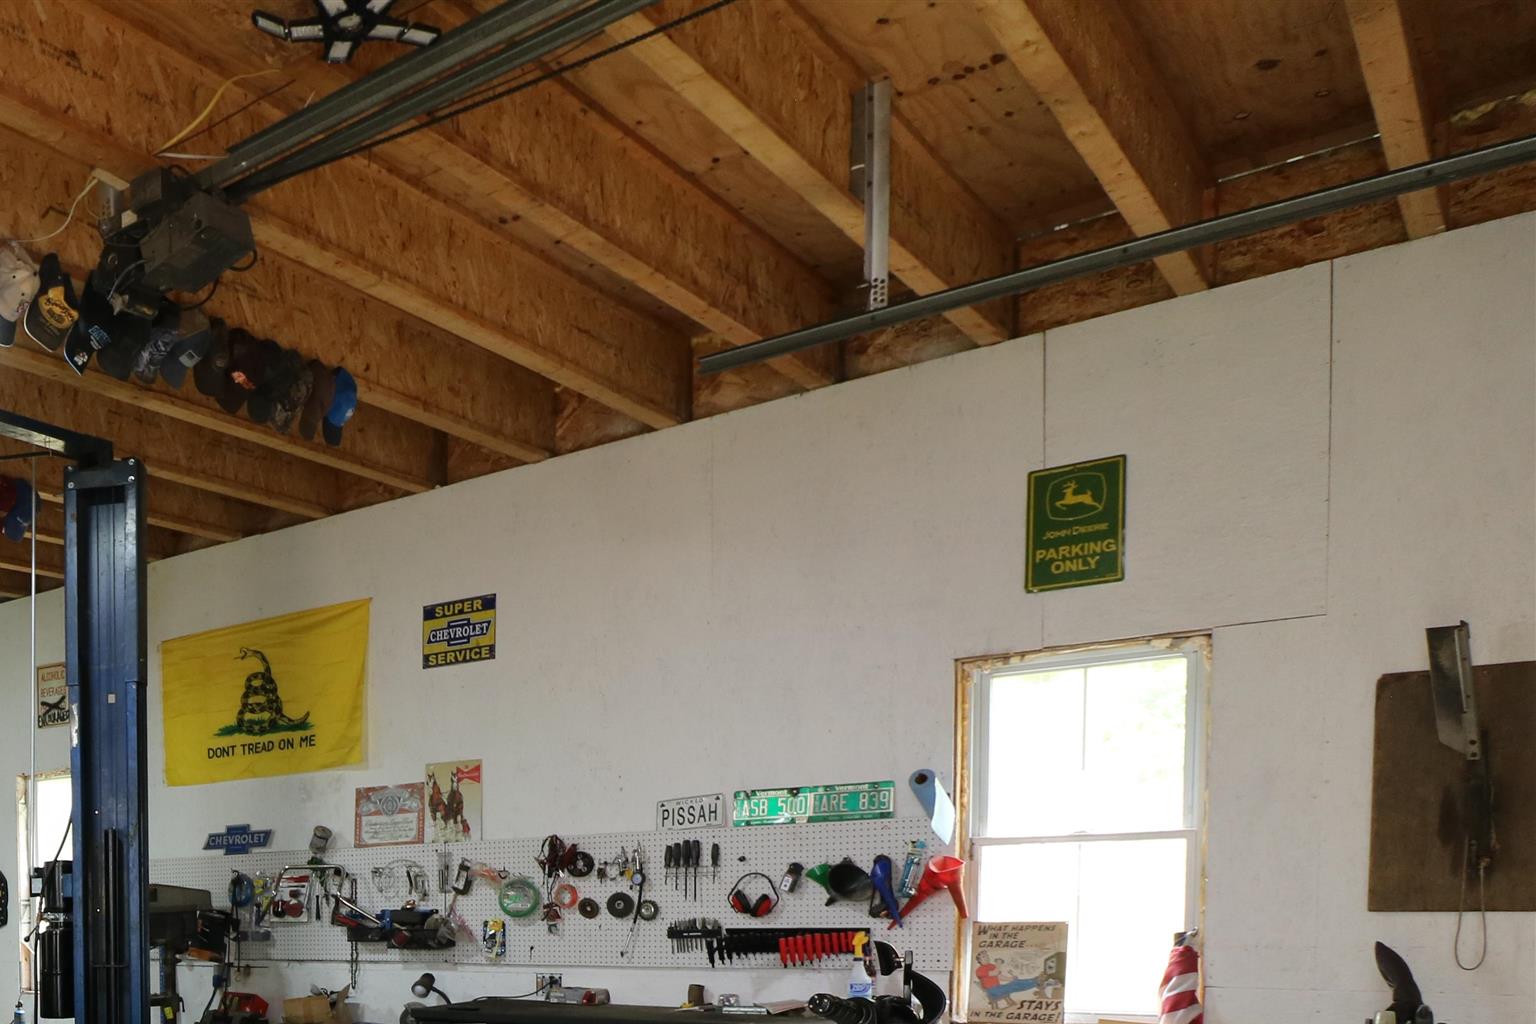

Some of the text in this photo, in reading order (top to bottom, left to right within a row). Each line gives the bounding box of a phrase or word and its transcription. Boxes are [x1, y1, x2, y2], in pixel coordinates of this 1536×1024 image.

[1035, 539, 1117, 563] PARKING
[1051, 556, 1100, 574] ONLY
[435, 599, 482, 617] SUPER
[430, 622, 488, 642] CHEVROLET
[428, 647, 490, 666] SERVICE
[207, 734, 316, 759] DONT TREAD ON ME
[662, 803, 718, 827] PISSAH
[209, 834, 265, 846] CHEVROLET
[977, 924, 1056, 935] WHAT HAPPENS
[1001, 931, 1020, 939] THE
[1017, 1000, 1062, 1011] STAYS
[970, 1010, 1061, 1022] IN THE GARAGE!
